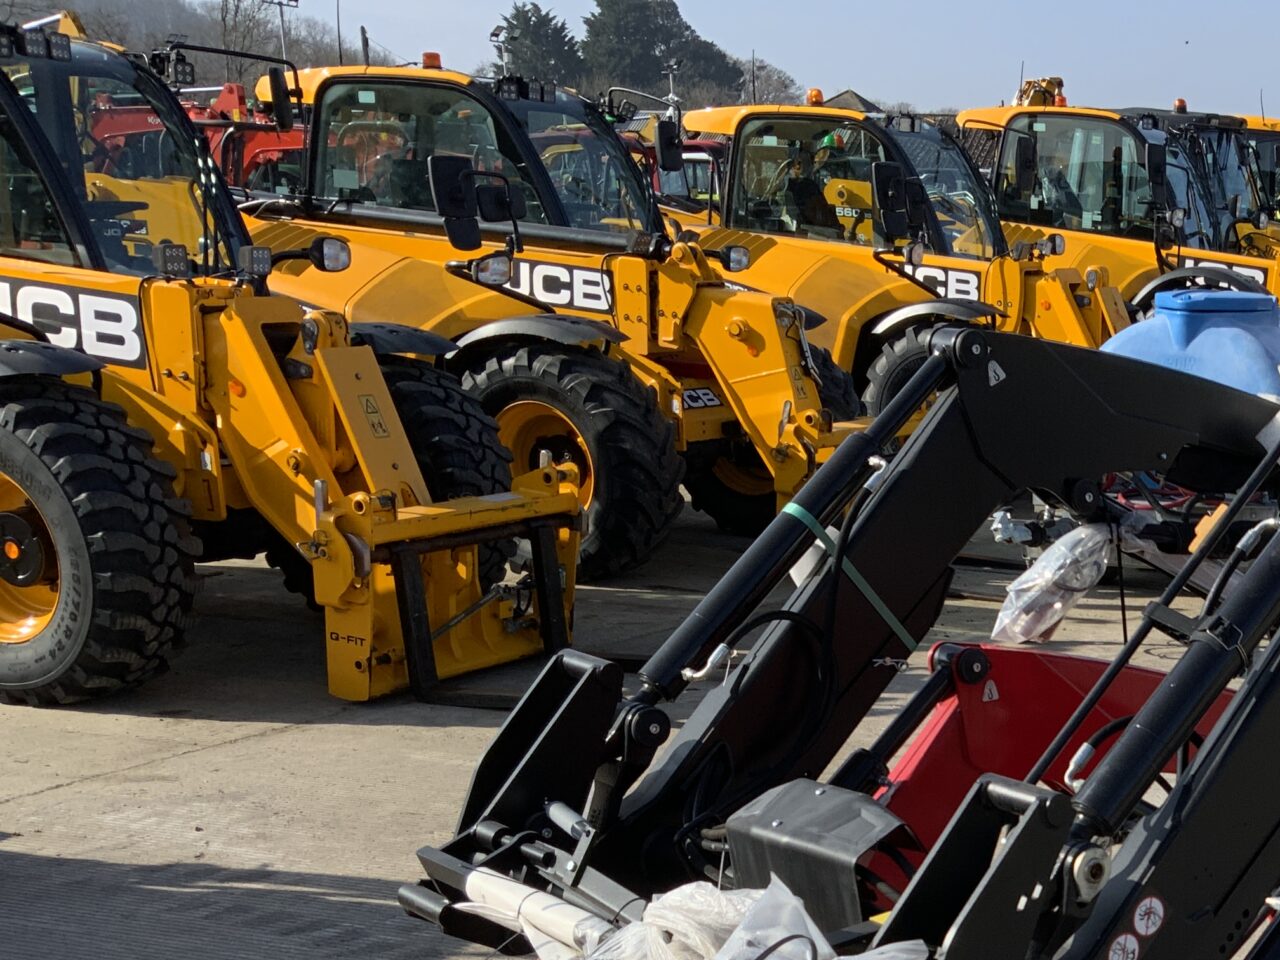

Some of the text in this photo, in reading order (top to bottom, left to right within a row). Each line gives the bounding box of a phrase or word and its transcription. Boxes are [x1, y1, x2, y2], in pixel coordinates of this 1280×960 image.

[502, 261, 613, 311] JCB
[683, 388, 721, 409] CB
[330, 631, 367, 647] Q-FIT
